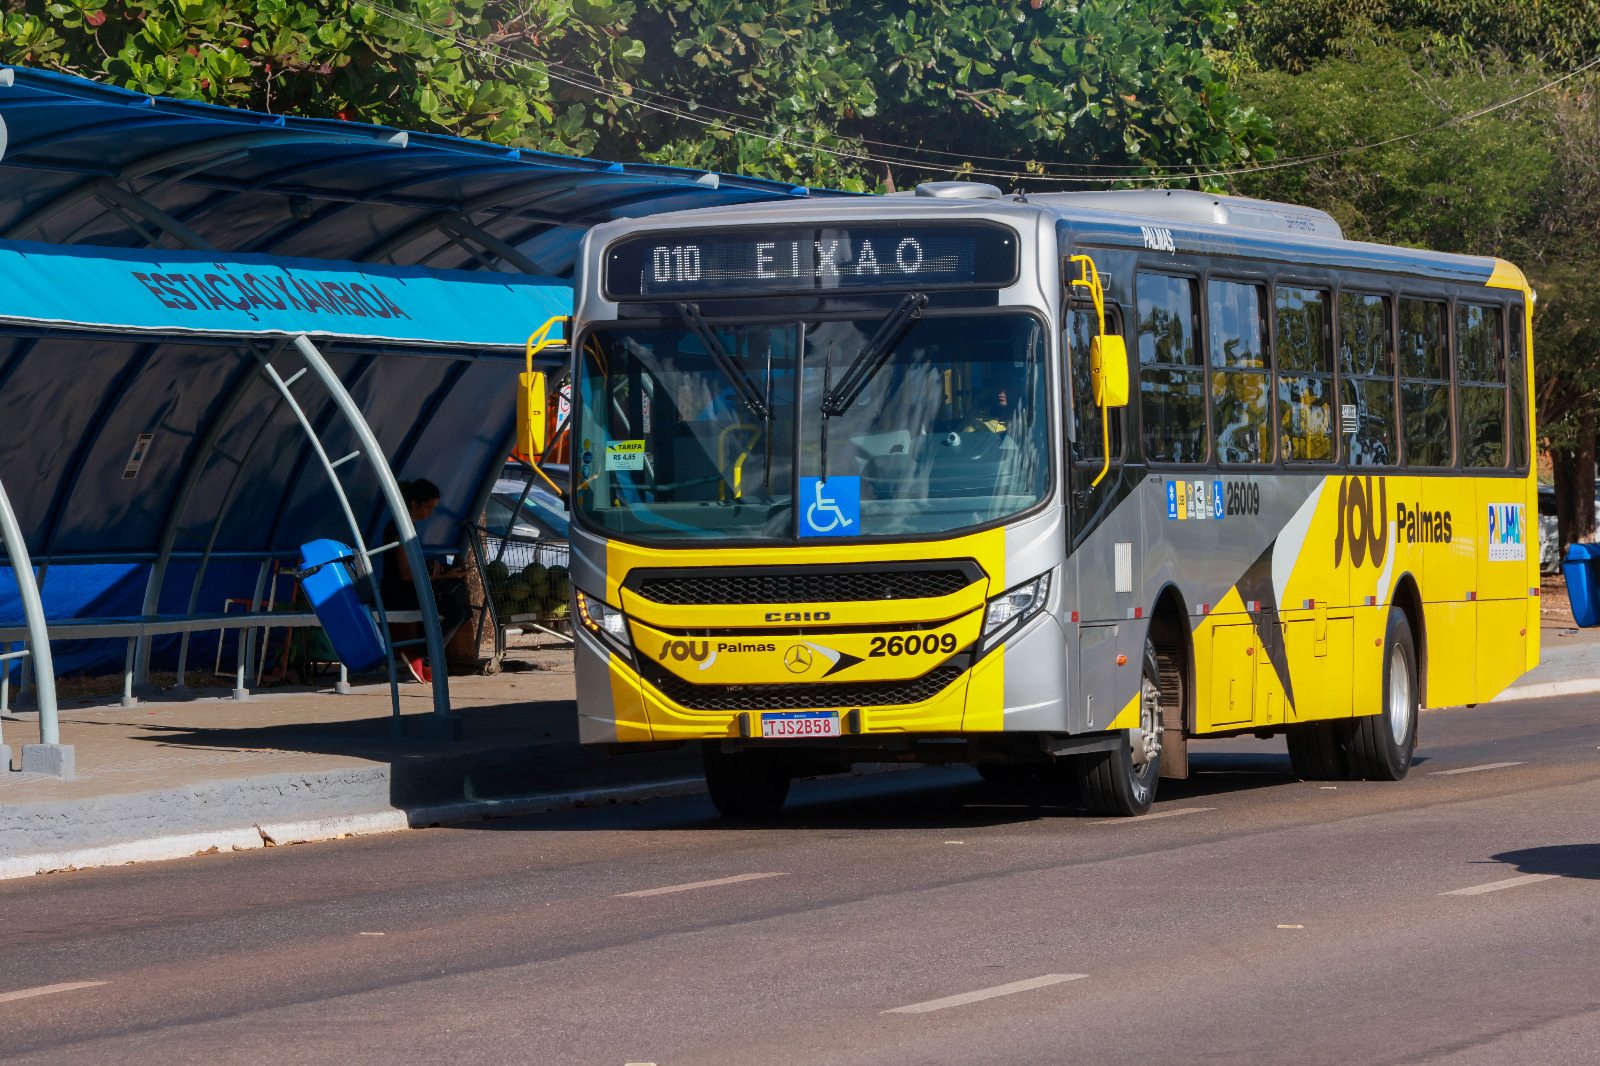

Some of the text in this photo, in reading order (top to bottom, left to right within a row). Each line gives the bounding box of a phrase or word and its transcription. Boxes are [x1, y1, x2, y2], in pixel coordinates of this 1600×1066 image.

[653, 237, 923, 282] 010 EIXAO
[1227, 481, 1260, 516] 26009
[1396, 502, 1453, 544] Palmas
[1489, 505, 1525, 544] PALMAS
[765, 611, 831, 622] CAIO
[717, 642, 776, 653] Palmas
[868, 633, 957, 658] 26009
[769, 719, 831, 735] TJS2B58
